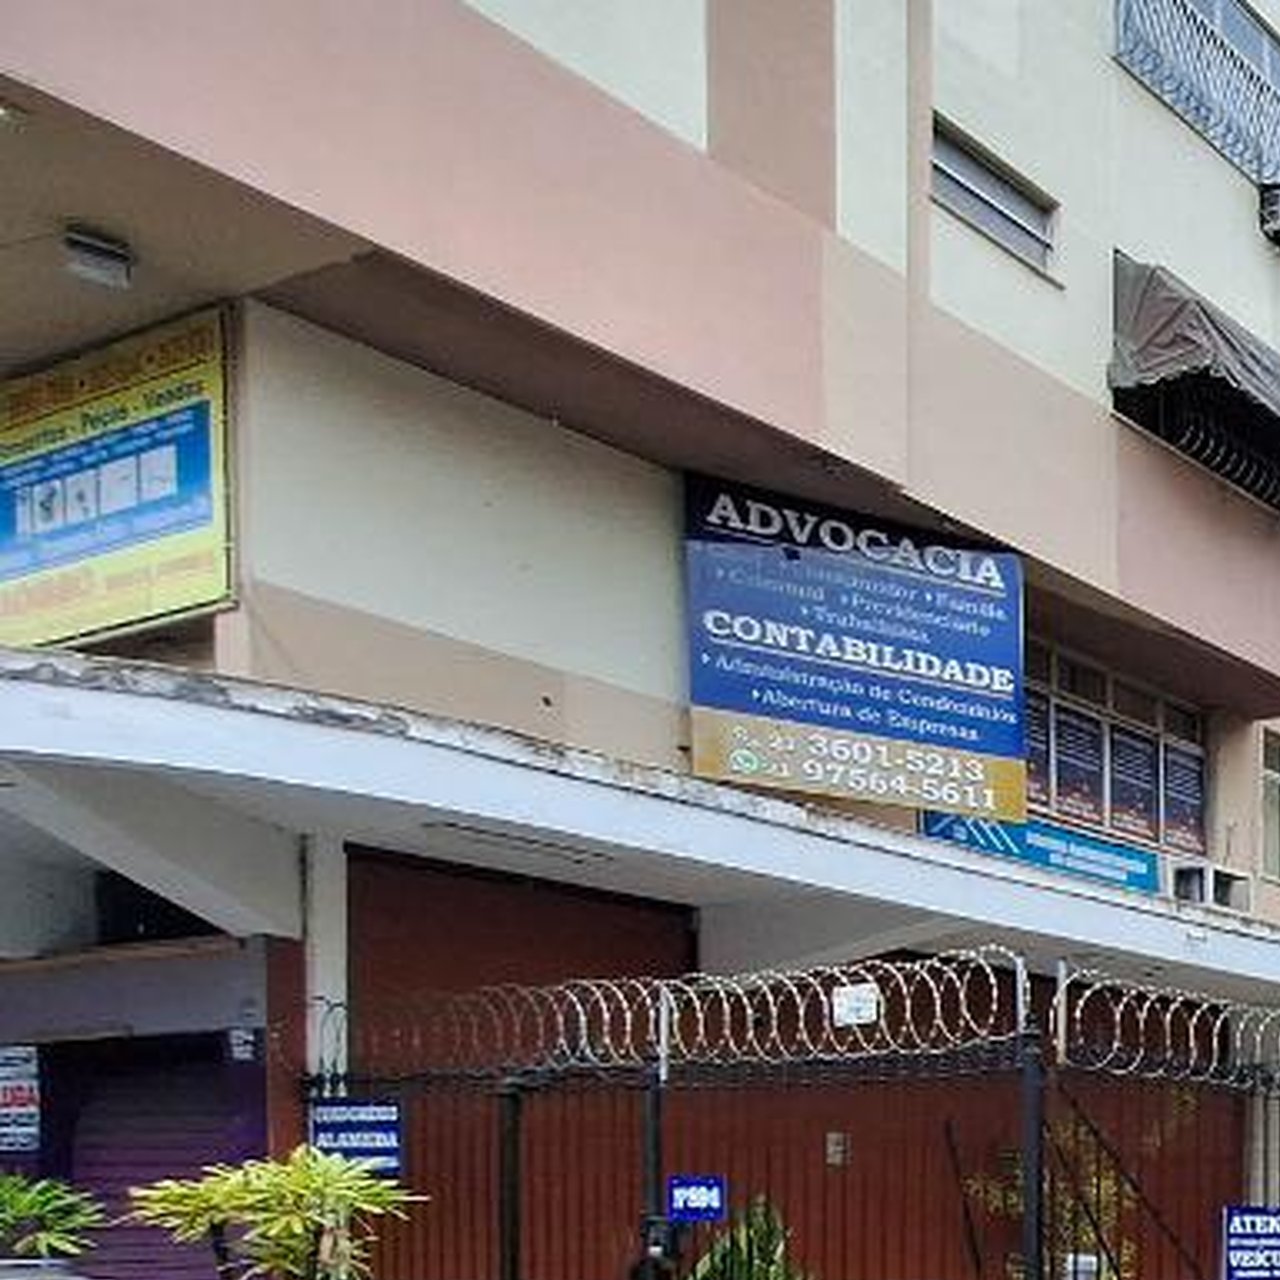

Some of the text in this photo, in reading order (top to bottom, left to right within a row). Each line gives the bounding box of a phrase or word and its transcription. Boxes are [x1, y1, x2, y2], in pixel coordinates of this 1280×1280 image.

[706, 494, 1006, 589] ADVOCACIA
[702, 609, 1016, 692] CONTABILIDADE
[762, 689, 852, 718] Abertura
[857, 704, 880, 723] de
[869, 676, 893, 700] de
[806, 733, 984, 783] 3601-5213
[803, 760, 999, 811] 97564-5611
